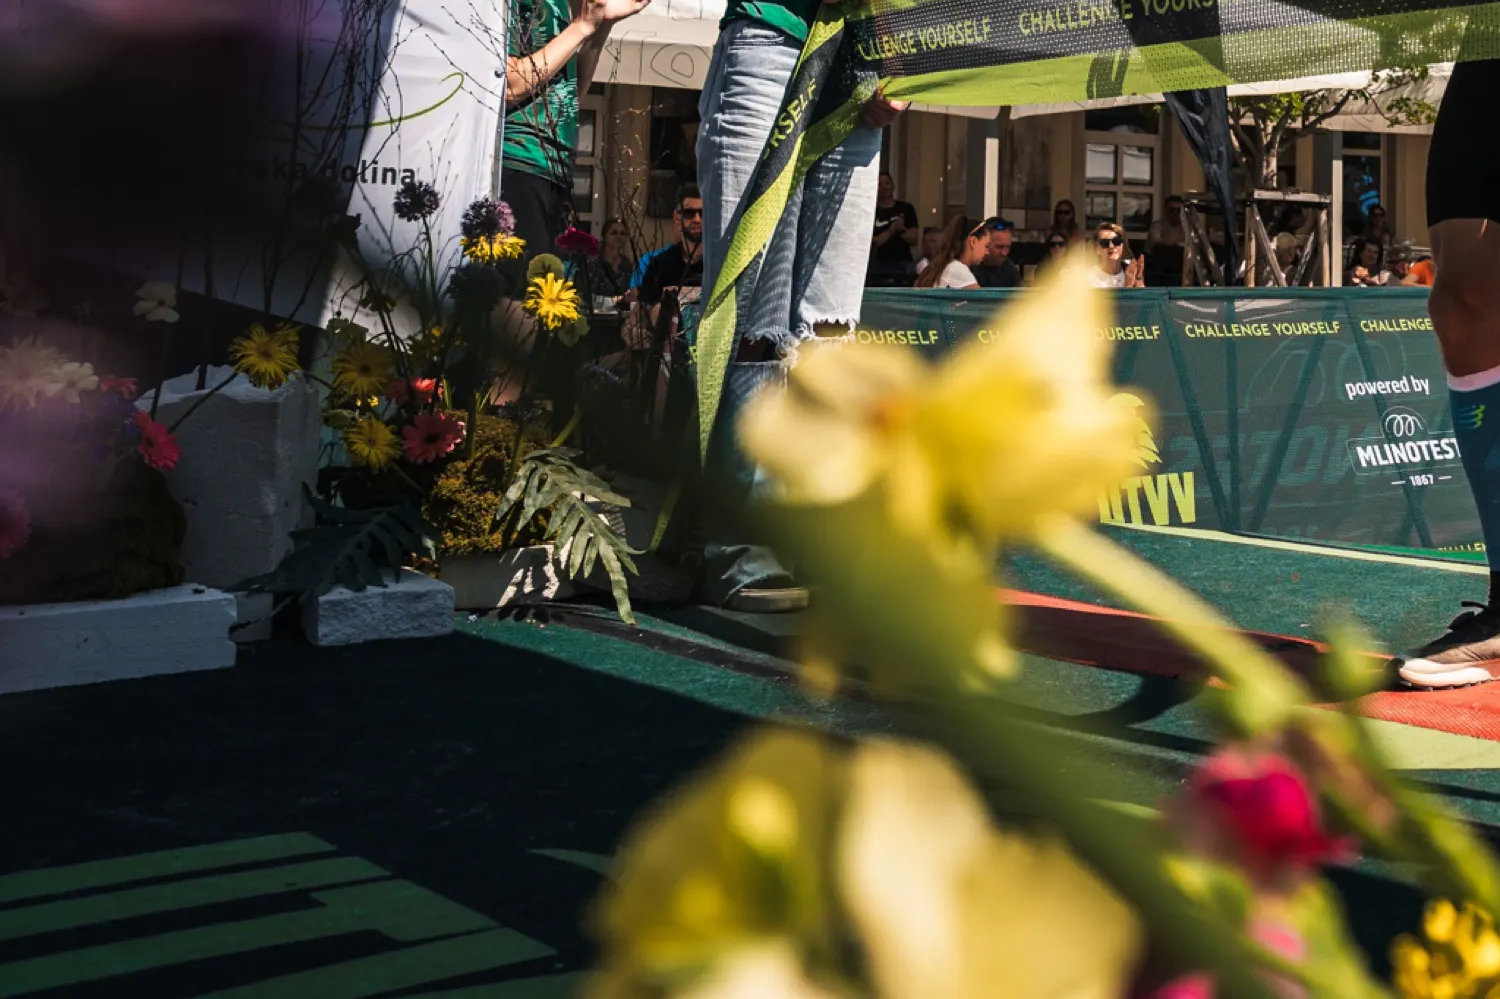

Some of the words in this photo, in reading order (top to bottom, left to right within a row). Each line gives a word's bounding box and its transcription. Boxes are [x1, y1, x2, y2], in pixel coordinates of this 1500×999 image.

[919, 18, 992, 51] YOURSELF
[1184, 323, 1271, 338] CHALLENGE
[1272, 320, 1340, 335] YOURSELF
[1360, 317, 1434, 333] CHALLENGE
[854, 329, 939, 345] OURSELF
[1344, 376, 1410, 401] powered
[1410, 375, 1430, 395] by
